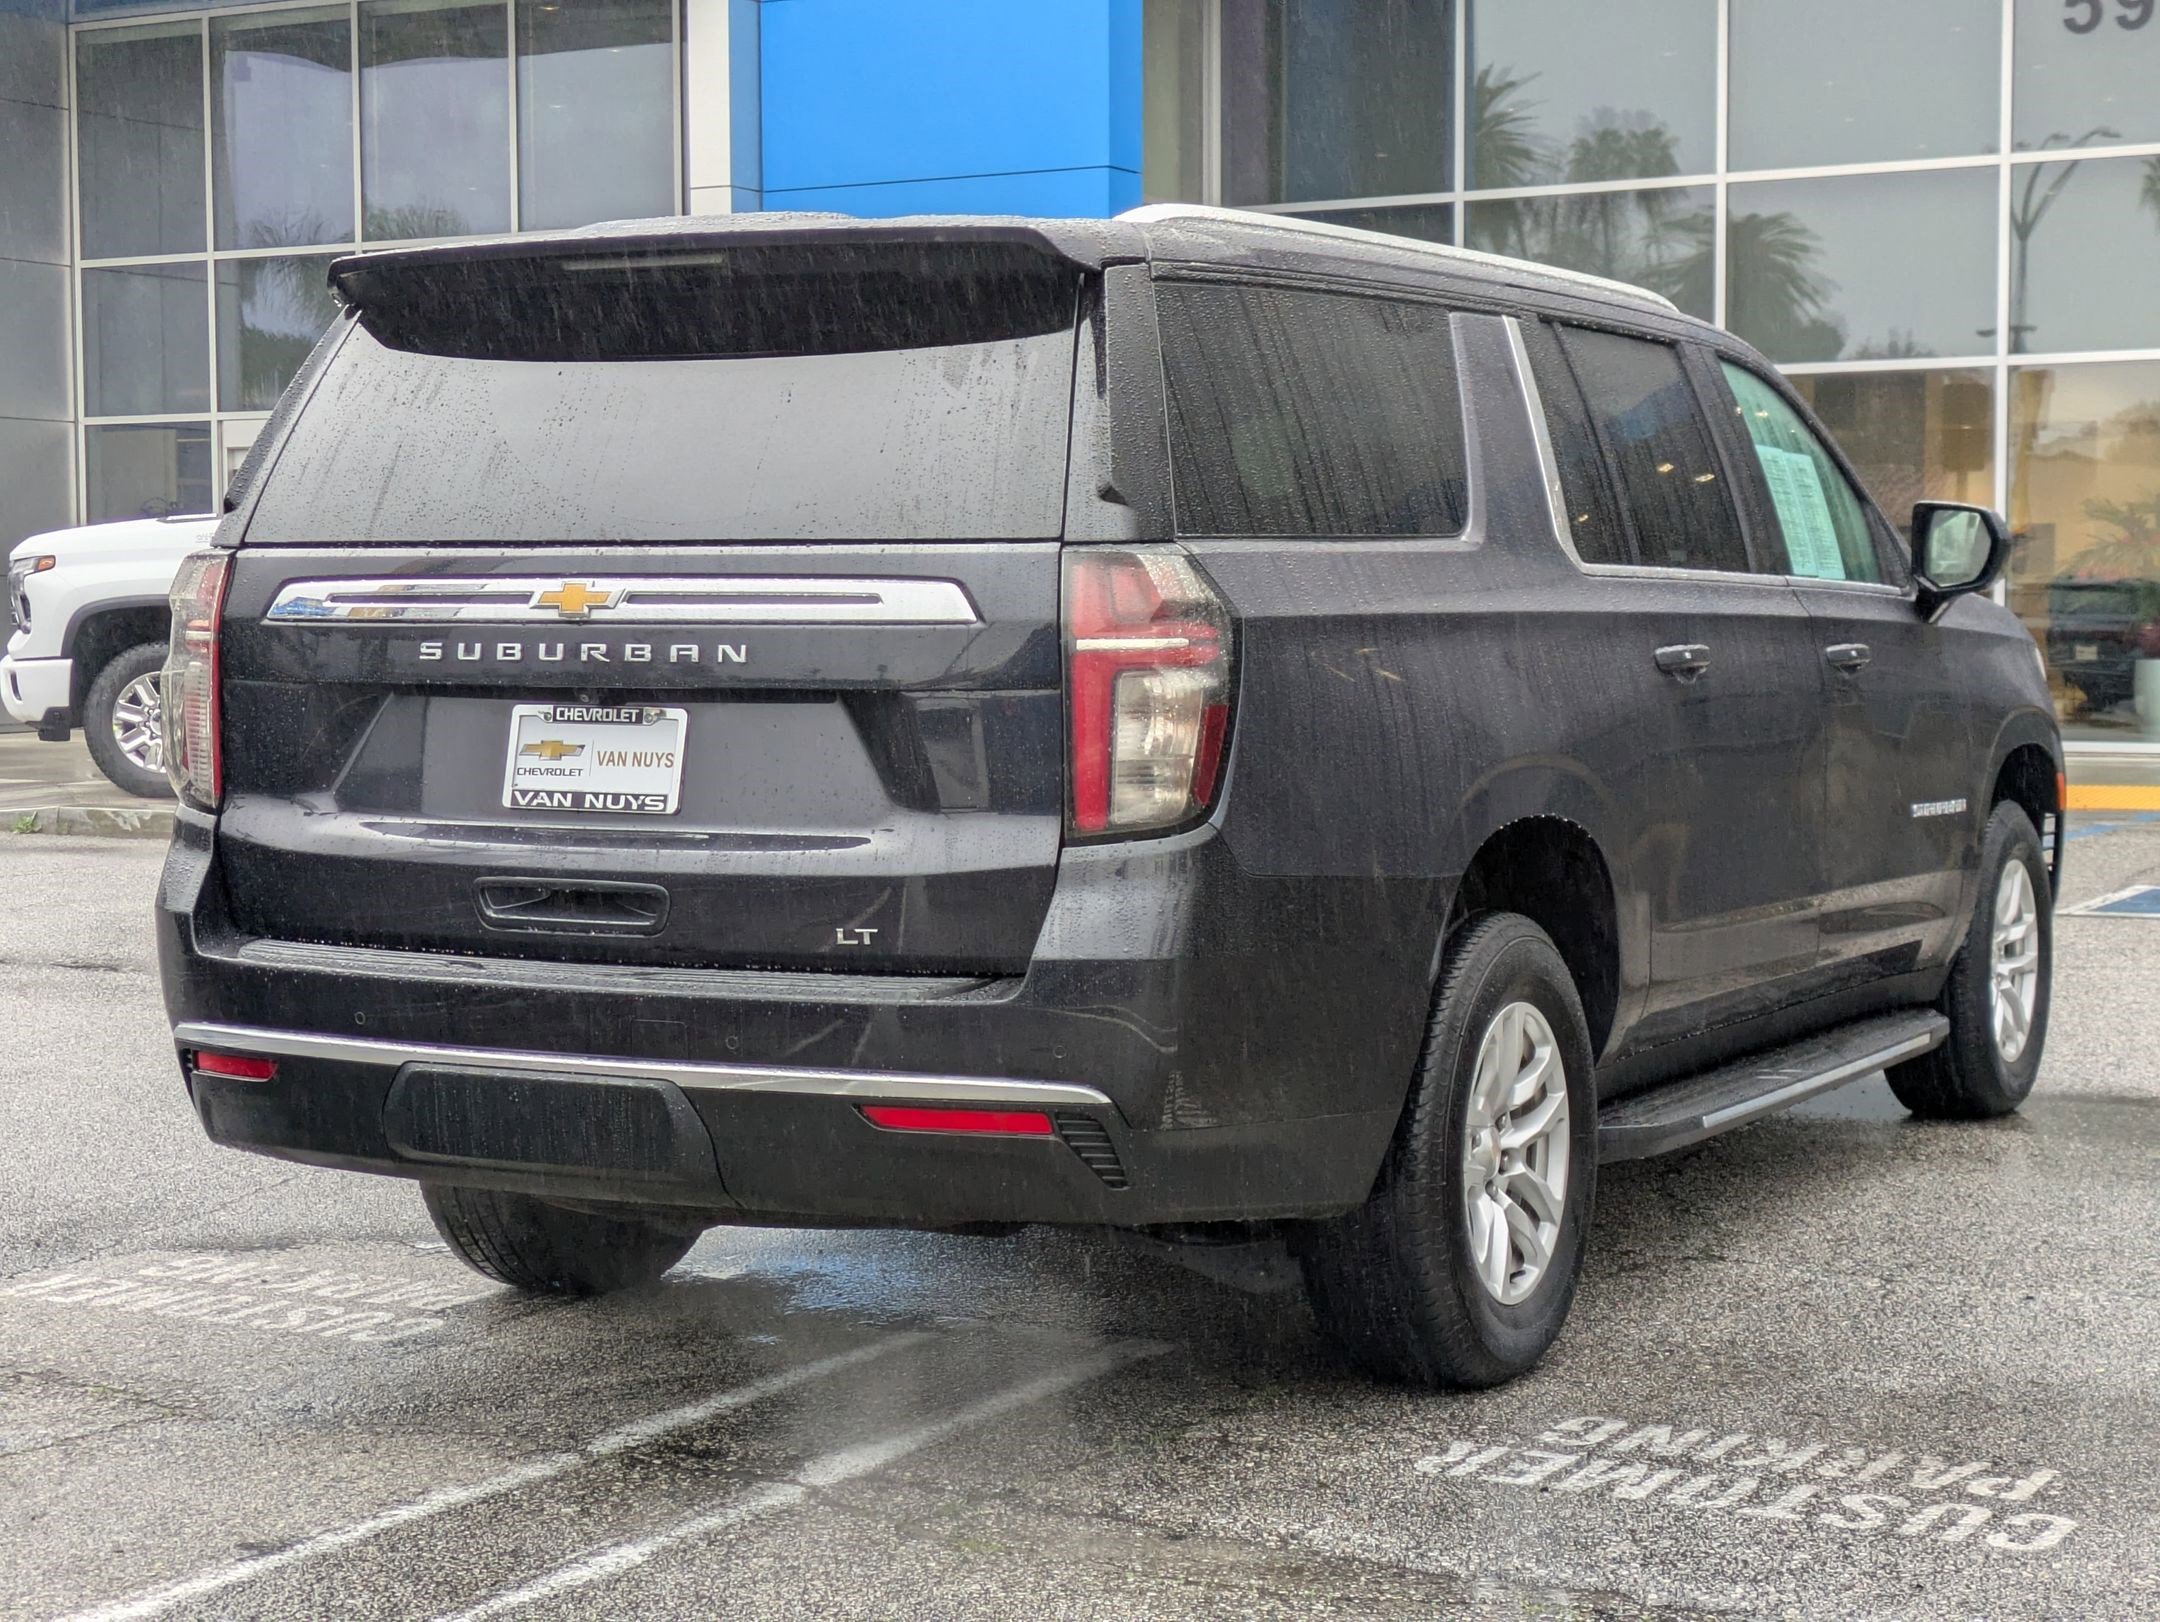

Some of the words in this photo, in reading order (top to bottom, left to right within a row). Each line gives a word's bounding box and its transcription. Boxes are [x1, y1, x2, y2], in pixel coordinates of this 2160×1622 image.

[419, 642, 746, 664] SUBURBAN
[556, 707, 640, 723] CHEVROLET
[597, 751, 627, 767] VAN
[632, 752, 674, 768] NUYS
[516, 767, 584, 777] CHEVROLET
[513, 790, 572, 808] VAN
[584, 793, 665, 811] NUYS
[836, 928, 878, 945] LT
[1534, 1415, 2062, 1502] PARKING
[1414, 1440, 2078, 1551] CUSTOMER
